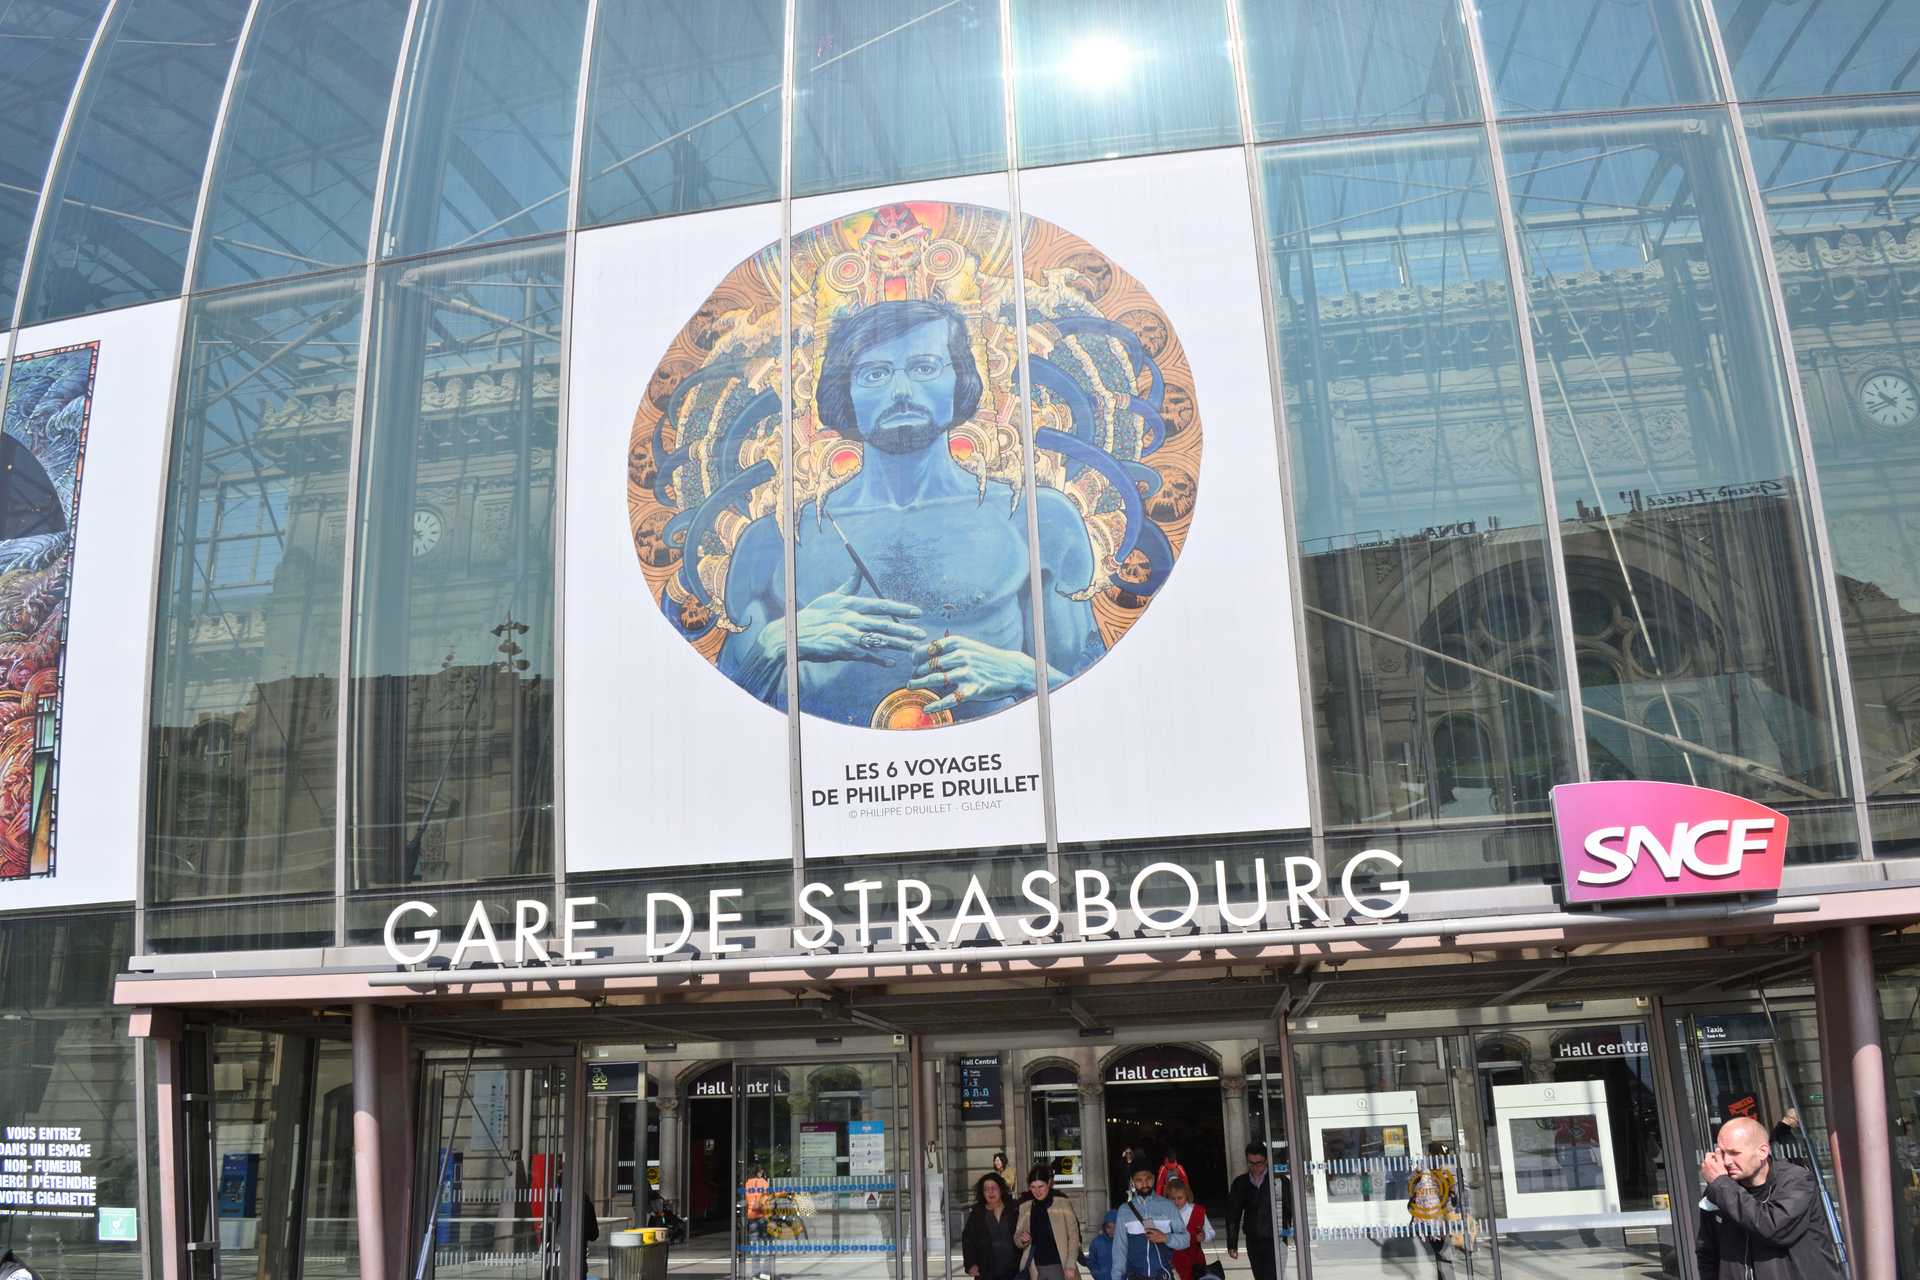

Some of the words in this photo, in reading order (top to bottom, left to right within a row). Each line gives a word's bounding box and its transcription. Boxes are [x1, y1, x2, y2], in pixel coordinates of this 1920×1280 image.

[845, 762, 879, 781] LES
[886, 761, 898, 778] 6
[905, 753, 1002, 777] VOYAGES
[811, 788, 839, 806] DE
[846, 782, 934, 804] PHILIPPE
[942, 774, 1040, 798] DRUILLET
[860, 805, 902, 818] PHILIPPE
[905, 803, 952, 816] DRUILLET
[1577, 818, 1775, 886] SNCF
[383, 896, 599, 966] GARE
[646, 888, 744, 957] DE
[793, 849, 1411, 949] STRASBOURG
[1560, 1042, 1593, 1057] Hall
[974, 1057, 998, 1065] Central
[1115, 1066, 1148, 1081] Hall
[1151, 1063, 1208, 1079] central
[696, 1081, 726, 1095] Hall
[729, 1079, 782, 1093] ntrl
[6, 1126, 37, 1140] VOUS
[39, 1127, 82, 1140] ENTREZ
[30, 1144, 46, 1156] UN
[48, 1144, 92, 1157] ESPACE
[4, 1159, 33, 1173] NON-
[35, 1160, 82, 1173] FUMEUR
[0, 1174, 27, 1188] ERCI
[32, 1171, 97, 1190] D'ÉTEINDRE
[0, 1190, 34, 1204] VOTRE
[36, 1191, 97, 1206] CIGARETTE
